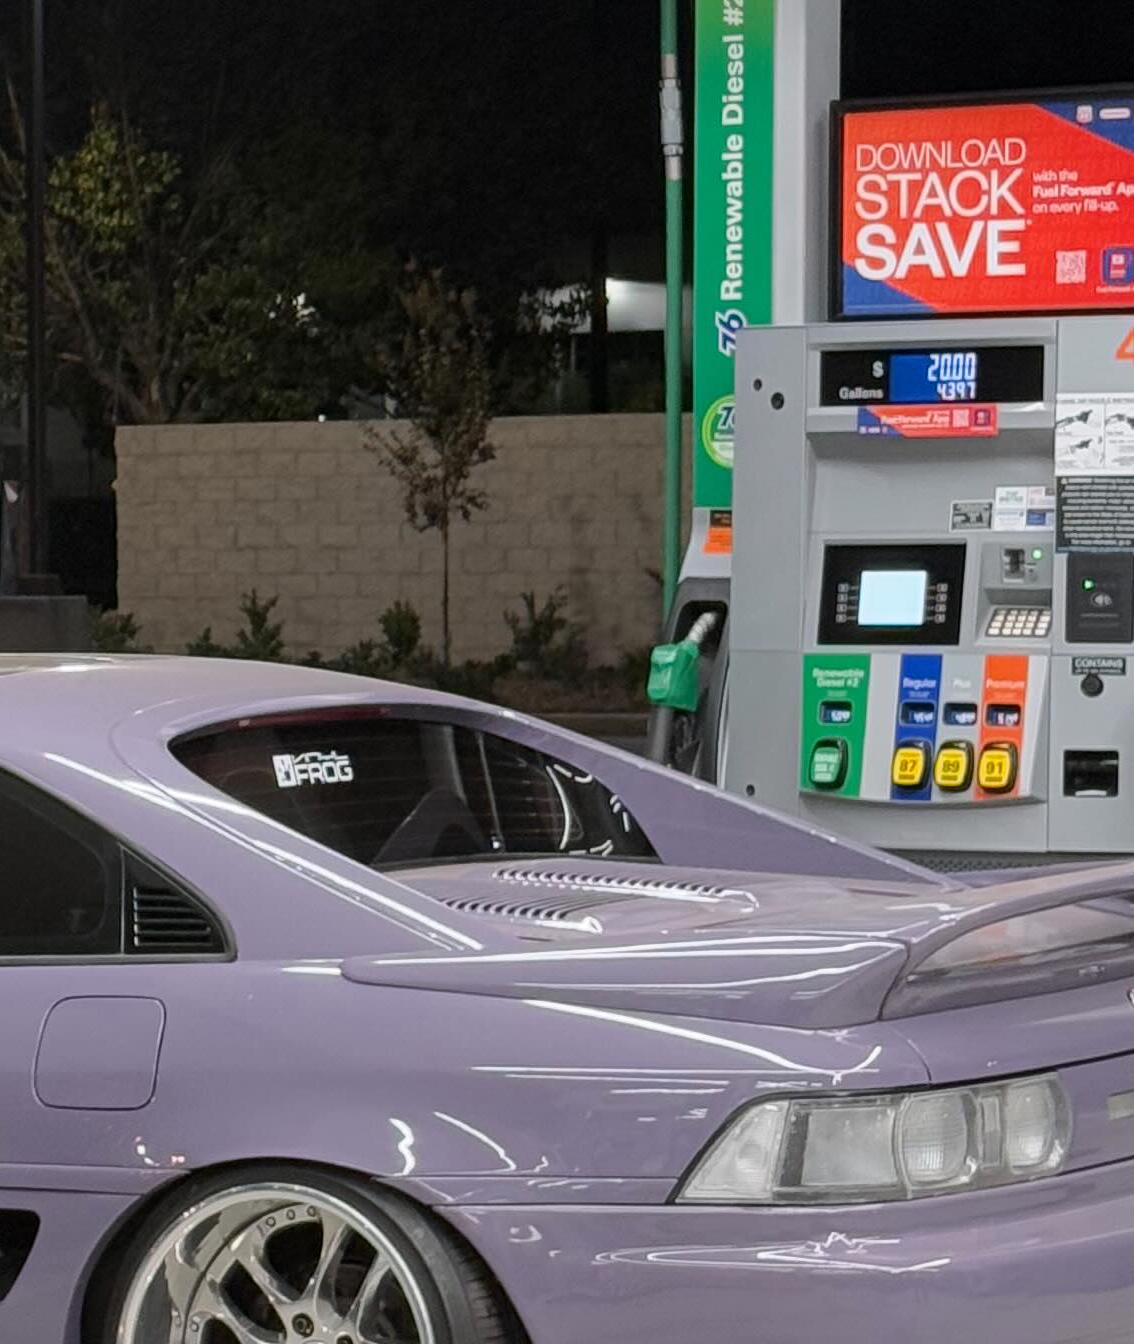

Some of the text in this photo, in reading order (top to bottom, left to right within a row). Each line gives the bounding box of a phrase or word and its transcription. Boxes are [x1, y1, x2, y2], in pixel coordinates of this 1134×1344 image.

[721, 34, 744, 127] Diesel
[855, 137, 1027, 172] DOWNLOAD
[1032, 169, 1058, 182] with
[855, 168, 1026, 221] STACK
[1032, 184, 1059, 198] Fuel
[1032, 203, 1048, 214] on
[720, 133, 744, 301] Renewable
[854, 219, 1027, 281] SAVE
[716, 309, 747, 356] 76
[838, 386, 884, 401] Gallons
[717, 405, 735, 430] 7
[812, 667, 865, 678] Renewable
[902, 677, 936, 690] Regular
[986, 677, 1025, 688] Premium
[295, 759, 354, 786] FROG
[899, 758, 917, 773] 87
[941, 759, 960, 774] 89
[985, 760, 1004, 775] 91
